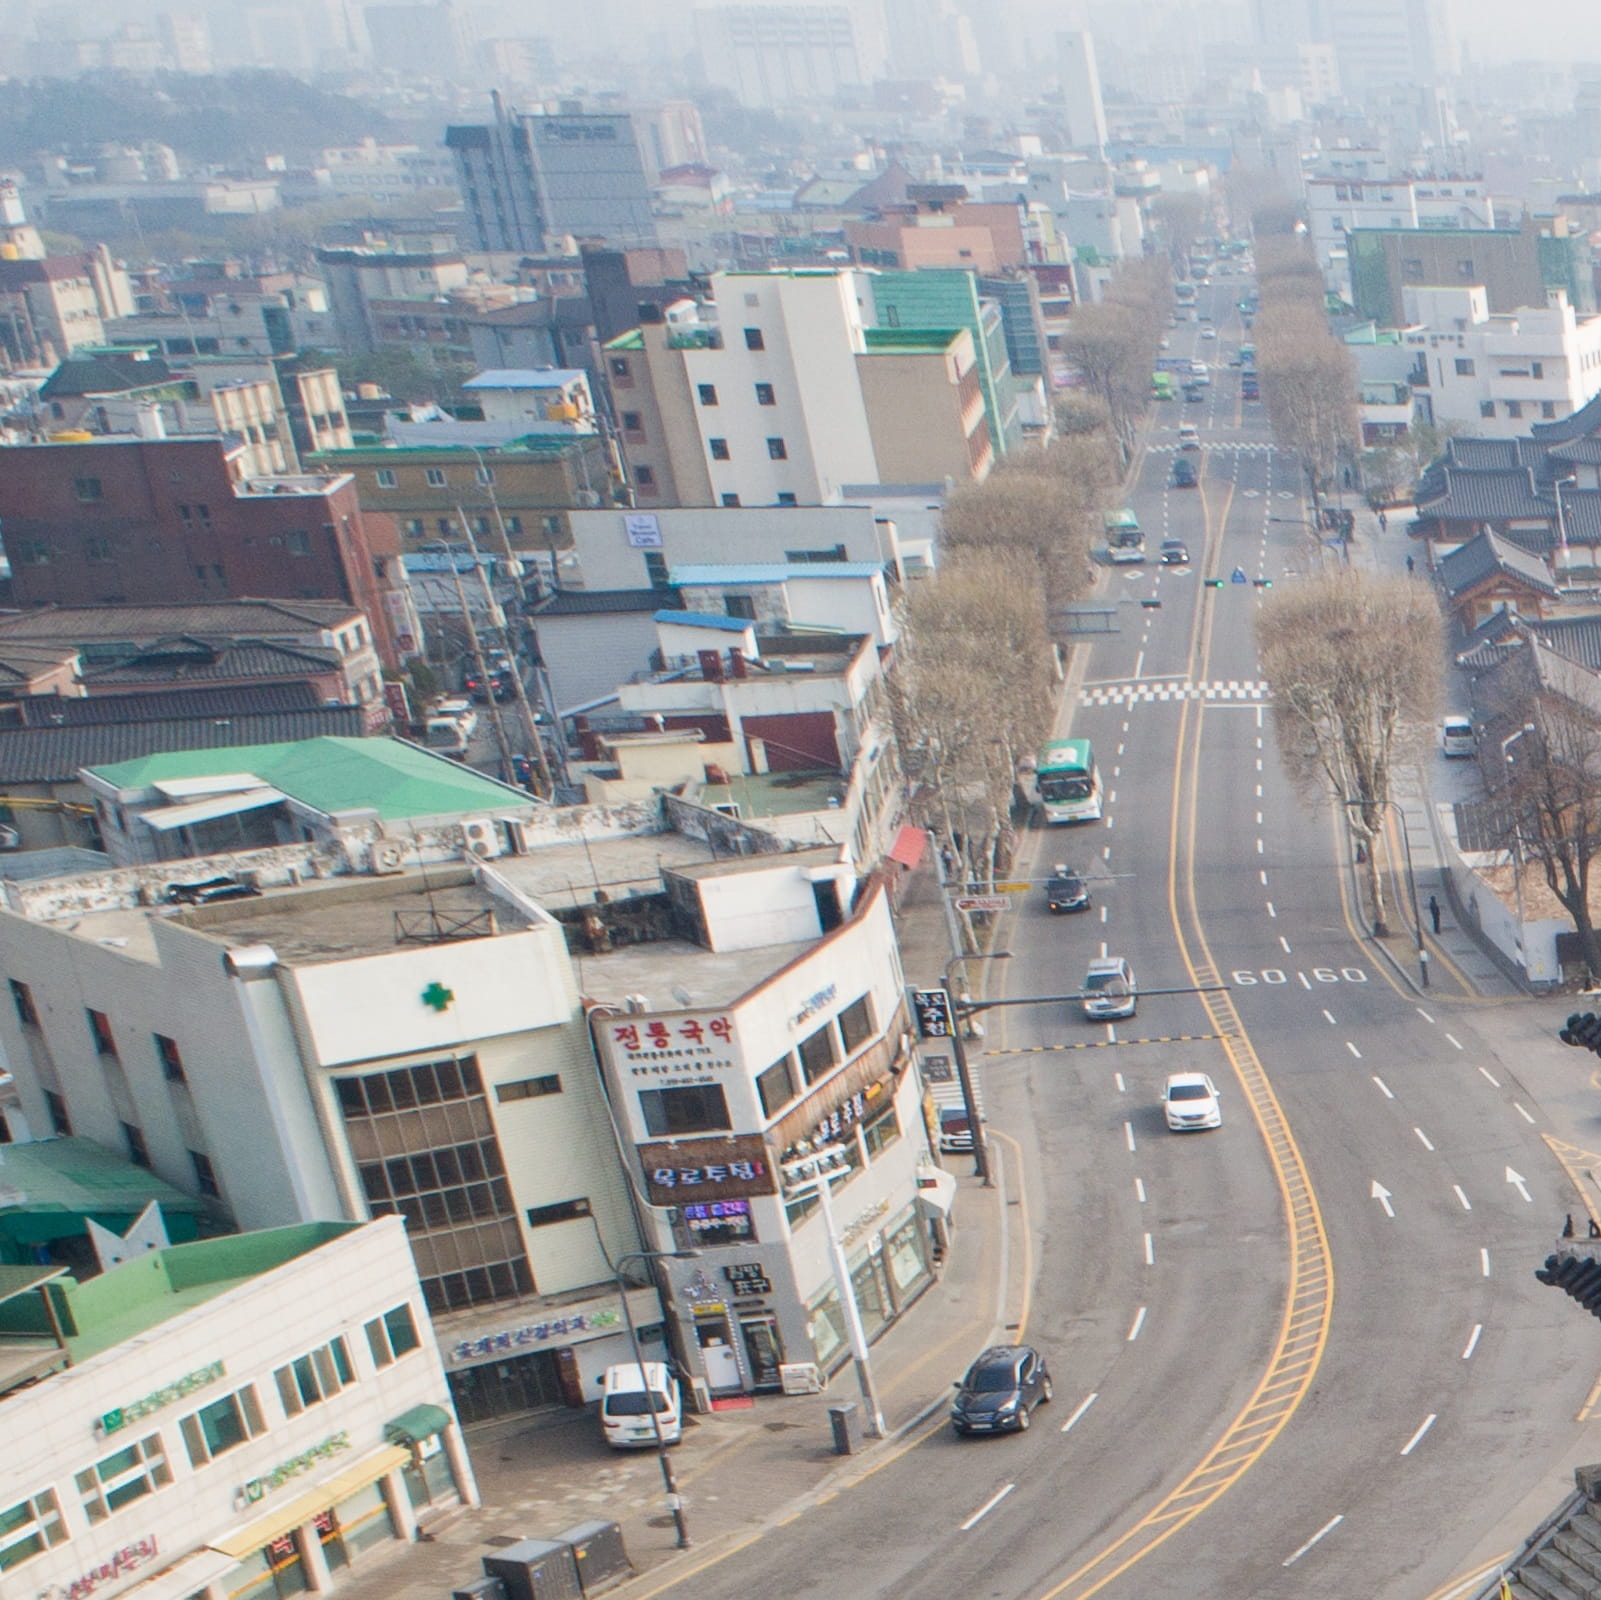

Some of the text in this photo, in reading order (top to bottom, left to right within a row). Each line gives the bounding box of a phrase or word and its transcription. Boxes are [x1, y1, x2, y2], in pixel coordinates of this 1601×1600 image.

[1232, 967, 1368, 986] 60 60
[614, 1016, 733, 1051] 전통국악
[653, 1159, 755, 1188] 목로주점
